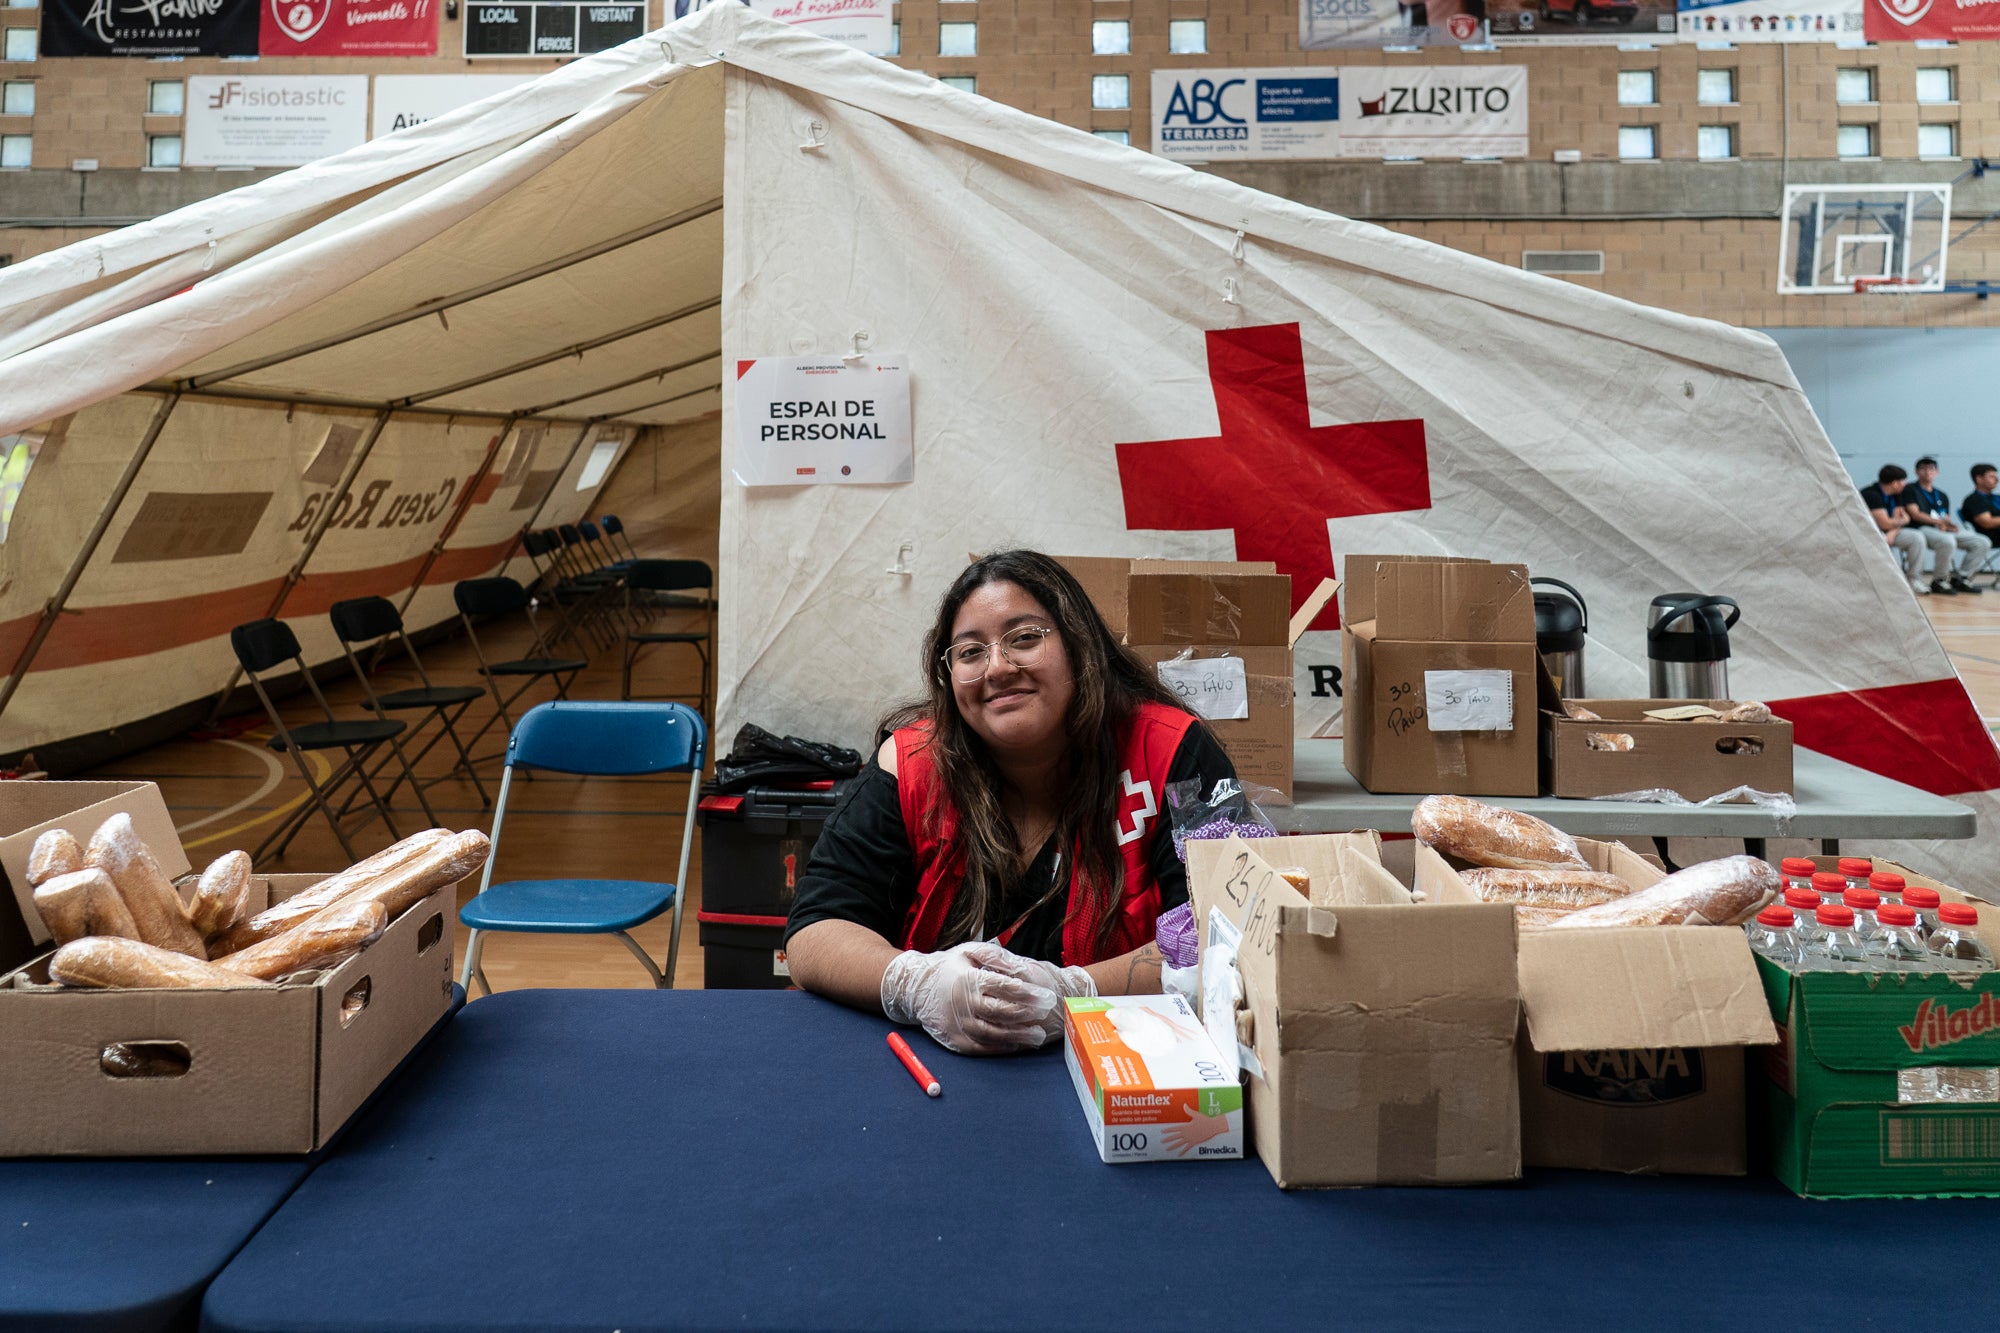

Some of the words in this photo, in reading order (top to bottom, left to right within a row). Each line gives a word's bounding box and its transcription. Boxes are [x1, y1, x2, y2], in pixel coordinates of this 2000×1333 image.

[346, 3, 408, 27] Vermells
[479, 8, 519, 23] LOCAL
[589, 8, 636, 22] VISITANT
[773, 1, 803, 17] amb
[1315, 0, 1371, 15] SOCIS
[115, 29, 202, 39] RESTAURANT
[226, 82, 346, 106] Fisiotastic
[1262, 87, 1290, 96] Experts
[1162, 79, 1247, 125] ABC
[1262, 97, 1332, 105] subministraments
[1390, 87, 1509, 113] ZURITO
[1163, 129, 1248, 140] TERRASSA
[1162, 144, 1213, 152] Connectant
[1216, 144, 1237, 152] amb
[770, 401, 836, 418] ESPAI
[845, 400, 875, 417] DE
[761, 423, 886, 441] PERSONAL
[1176, 680, 1198, 697] 30
[1390, 682, 1412, 702] 30
[1445, 690, 1463, 706] 30
[784, 855, 797, 887] 1
[1225, 852, 1256, 908] 25
[1195, 1061, 1225, 1082] 100
[1111, 1093, 1171, 1107] Naturflex
[1209, 1092, 1219, 1107] L
[1112, 1133, 1148, 1152] 100
